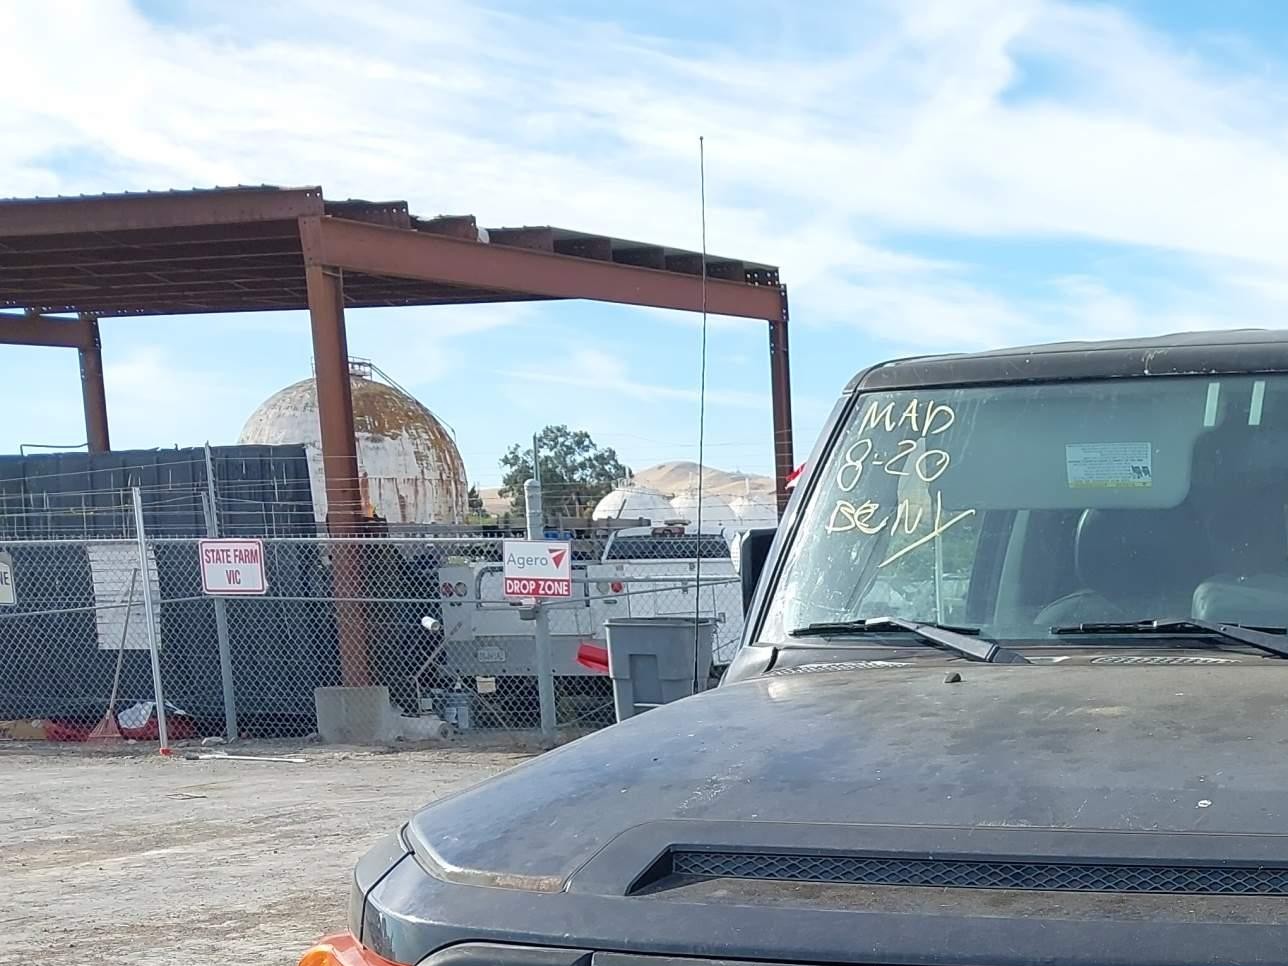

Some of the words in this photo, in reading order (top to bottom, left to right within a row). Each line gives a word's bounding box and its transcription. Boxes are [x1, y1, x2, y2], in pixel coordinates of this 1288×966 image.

[858, 398, 955, 437] MAD
[836, 438, 950, 491] 8-20
[204, 549, 231, 564] STATE
[233, 549, 259, 564] FARM
[506, 553, 548, 569] Agero
[225, 570, 241, 585] VIC
[506, 580, 536, 594] DROP
[538, 581, 569, 595] ZONE
